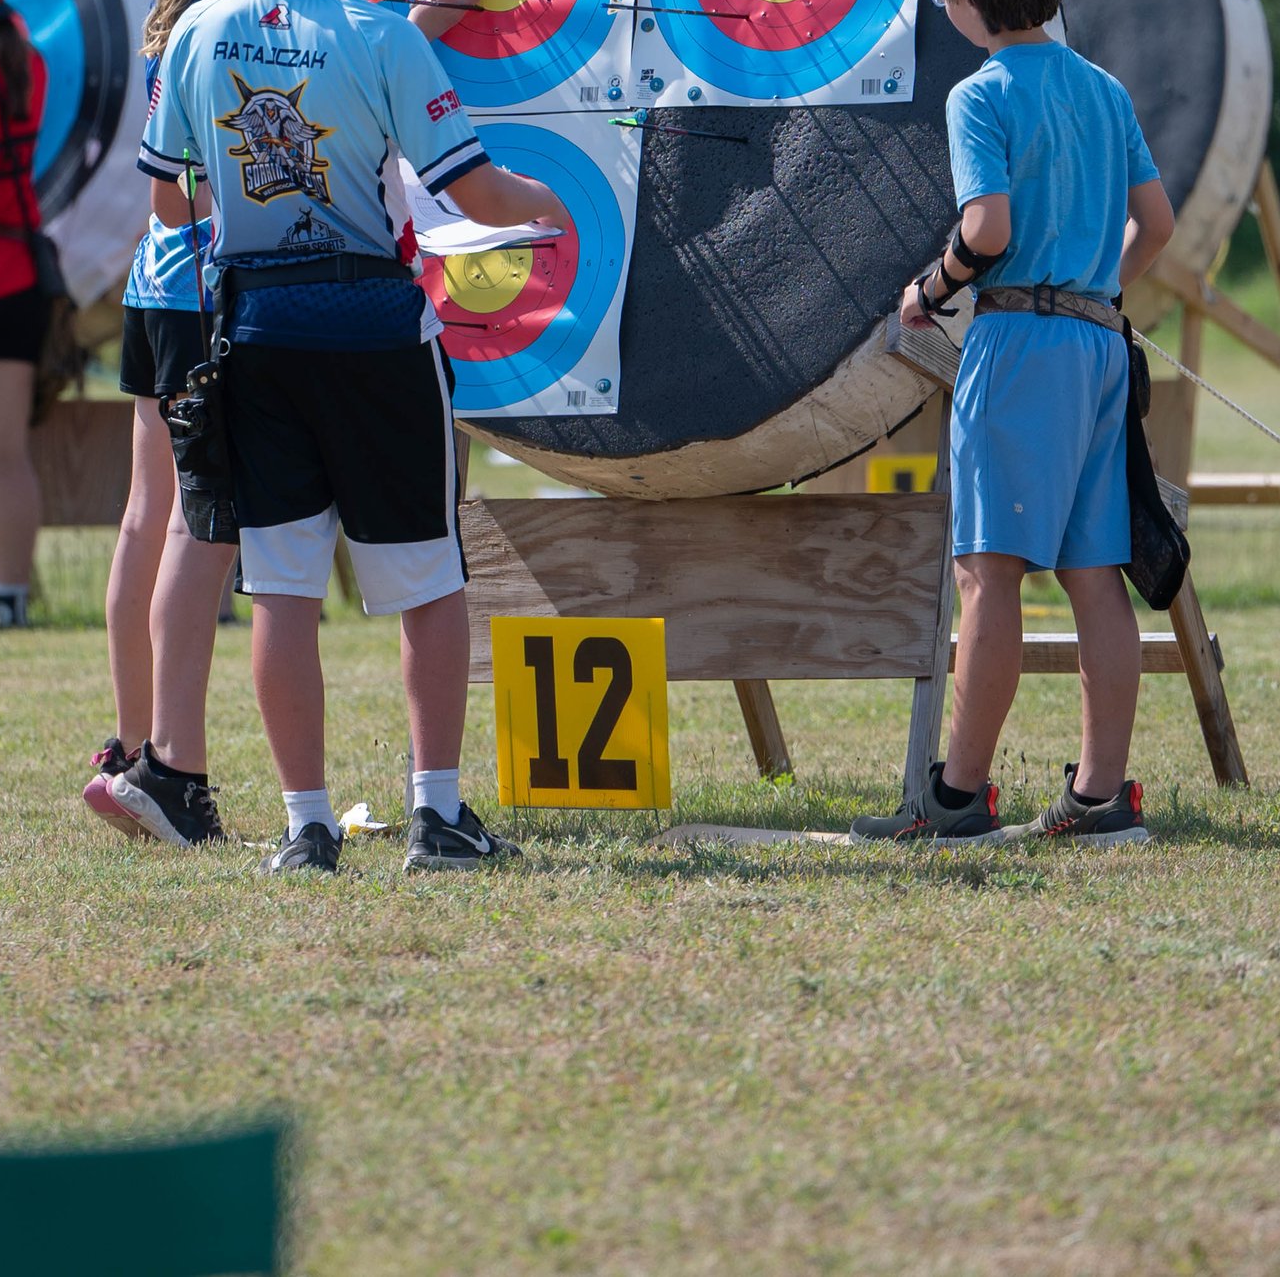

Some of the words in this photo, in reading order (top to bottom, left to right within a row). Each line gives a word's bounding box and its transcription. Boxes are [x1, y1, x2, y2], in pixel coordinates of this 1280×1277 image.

[213, 41, 328, 70] RATAJCZAK
[311, 238, 346, 250] SPORTS
[586, 259, 591, 267] 6
[609, 258, 615, 267] 5
[524, 636, 638, 791] 12
